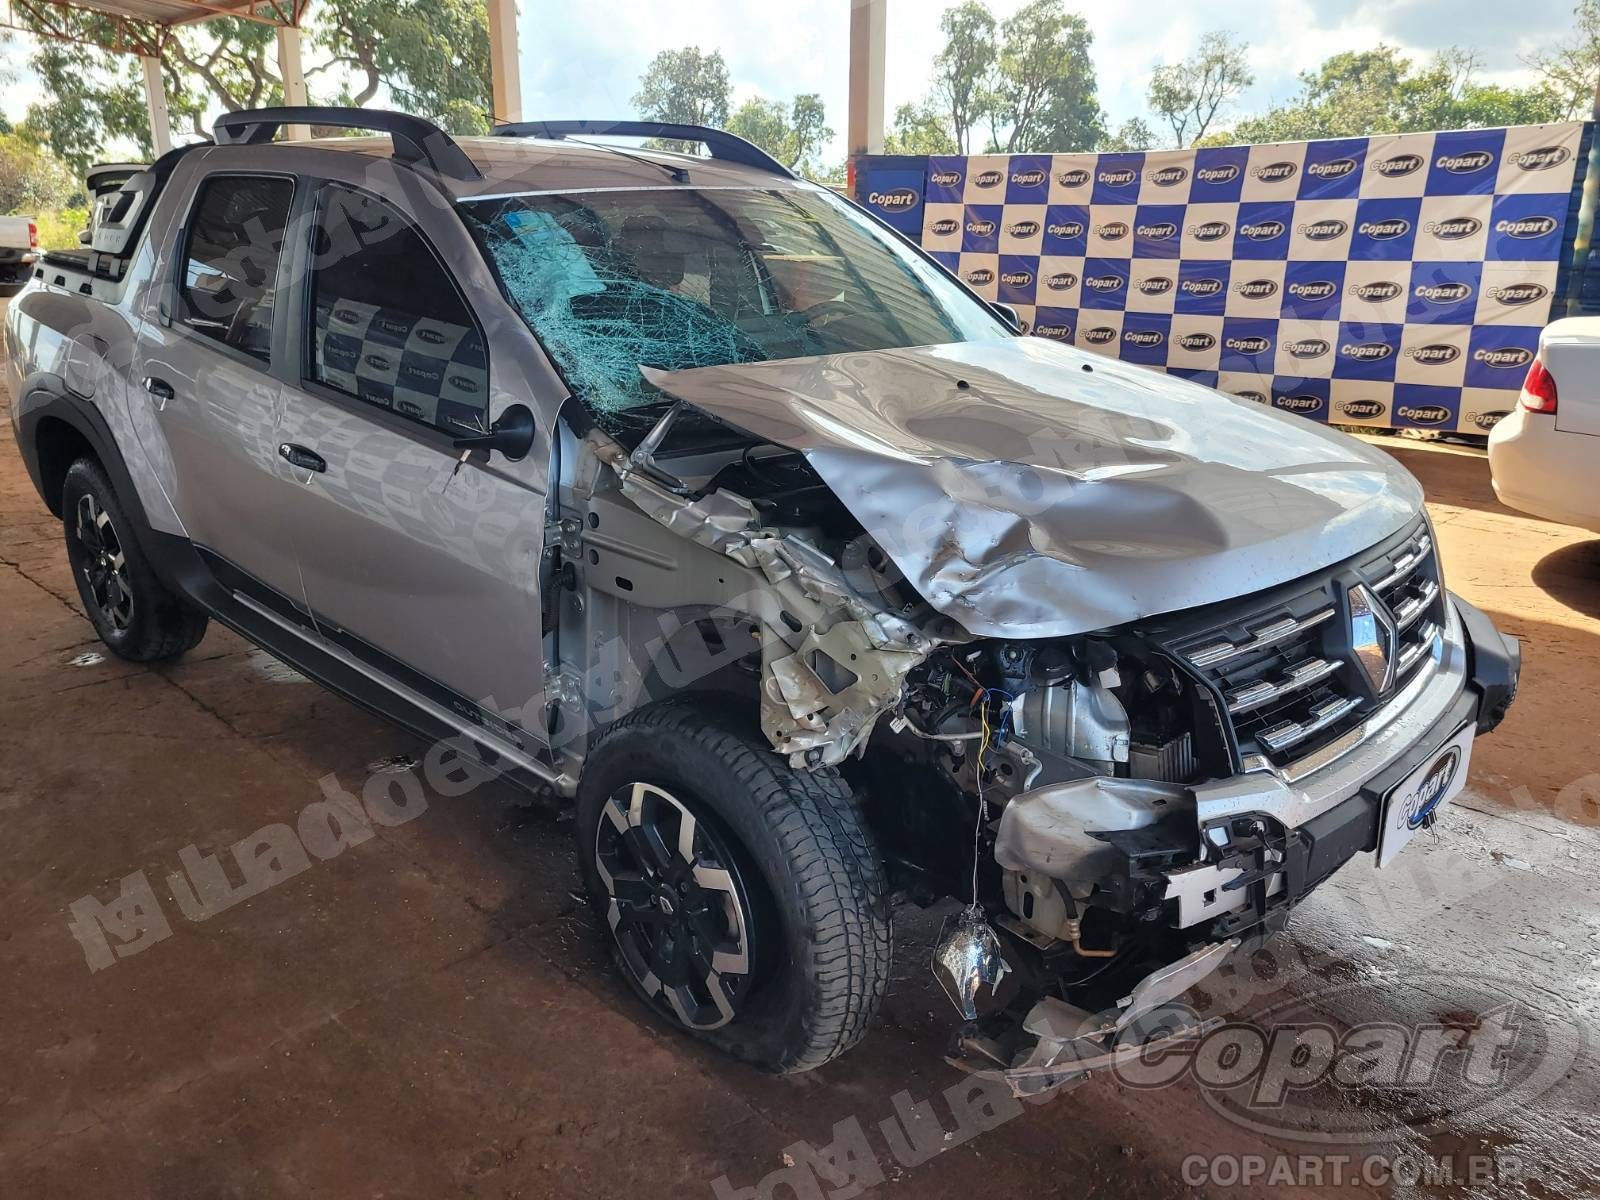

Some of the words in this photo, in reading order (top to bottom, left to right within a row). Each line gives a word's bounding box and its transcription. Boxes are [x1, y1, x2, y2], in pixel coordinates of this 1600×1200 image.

[1436, 154, 1486, 170] Copart
[1507, 149, 1560, 165] Copart
[1251, 164, 1292, 178] Copart
[1308, 161, 1351, 176] Copart
[1370, 158, 1416, 173] Copart
[931, 173, 958, 185] Copart
[1011, 173, 1042, 184] Copart
[1099, 171, 1132, 184] Copart
[1146, 170, 1182, 183] Copart
[1197, 168, 1233, 181] Copart
[868, 192, 913, 208] Copart
[966, 222, 992, 234] Copart
[1005, 222, 1036, 235] Copart
[1047, 224, 1080, 237] Copart
[1093, 224, 1124, 238] Copart
[1137, 224, 1172, 238] Copart
[1187, 223, 1224, 238] Copart
[1240, 223, 1279, 237] Copart
[1297, 222, 1340, 237] Copart
[1358, 221, 1404, 236] Copart
[1423, 220, 1473, 236] Copart
[1495, 219, 1550, 236] Copart
[963, 271, 992, 284] Copart
[1001, 273, 1029, 286] Copart
[1041, 275, 1072, 288] Copart
[1085, 276, 1118, 290] Copart
[1133, 278, 1167, 292] Copart
[1181, 280, 1217, 294] Copart
[1232, 282, 1272, 296] Copart
[1289, 282, 1331, 297] Copart
[1349, 284, 1396, 299] Copart
[1415, 283, 1464, 299] Copart
[1486, 284, 1538, 301] Copart
[1036, 324, 1067, 338] Copart
[1080, 327, 1111, 341] Copart
[1124, 331, 1159, 345] Copart
[1174, 335, 1211, 348] Copart
[1226, 337, 1265, 351] Copart
[1282, 340, 1324, 355] Copart
[1341, 343, 1387, 358] Copart
[1404, 345, 1454, 361] Copart
[1474, 349, 1527, 365] Copart
[1276, 395, 1317, 410] Copart
[1335, 400, 1378, 415] Copart
[1397, 405, 1445, 421] Copart
[1397, 753, 1455, 829] Copart
